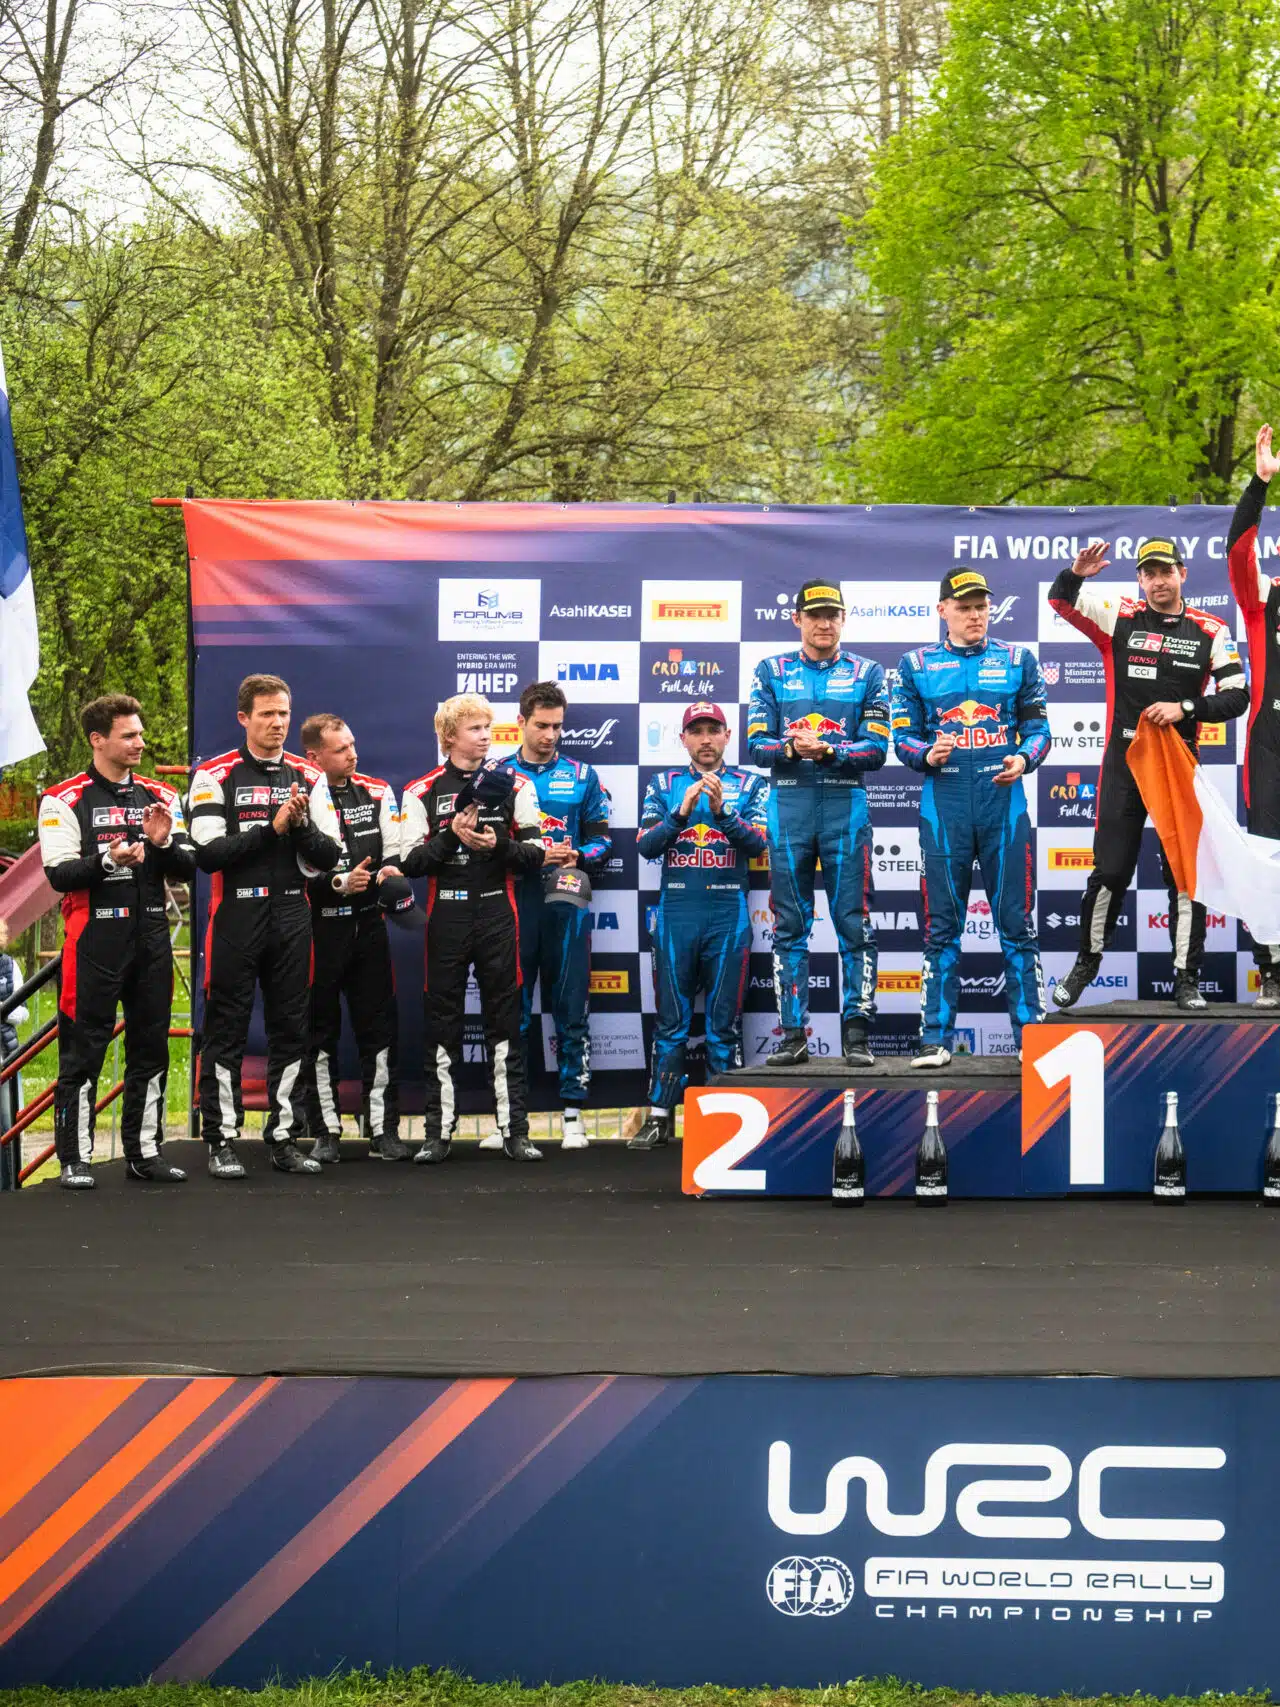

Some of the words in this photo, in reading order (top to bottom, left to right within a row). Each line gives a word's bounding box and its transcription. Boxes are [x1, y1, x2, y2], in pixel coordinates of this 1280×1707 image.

[953, 535, 999, 559] FIA
[1203, 595, 1229, 607] FUELS
[453, 610, 523, 619] FORUM8
[550, 604, 632, 618] AsahiKASEI
[658, 603, 722, 618] PIRELLI
[754, 608, 777, 621] TW
[850, 605, 930, 618] AsahiKASEI
[1129, 634, 1162, 652] GR
[1164, 636, 1200, 646] TOYOTA
[1164, 642, 1197, 651] GAZOO
[1162, 648, 1195, 657] Racing
[1128, 655, 1157, 665] DENSO
[652, 659, 723, 676] CROATIA
[1064, 668, 1097, 677] Ministry
[478, 673, 518, 693] HEP
[972, 725, 1009, 748] Bull
[1051, 736, 1074, 748] TW
[1077, 736, 1104, 748] STE
[236, 791, 269, 804] GR
[897, 791, 906, 800] of
[1050, 783, 1095, 800] CROA
[343, 803, 375, 813] TOYOTA
[891, 800, 904, 808] and
[94, 810, 126, 826] GR
[238, 811, 268, 819] DENSO
[344, 811, 373, 819] GAZOO
[344, 816, 373, 825] Racing
[97, 832, 127, 841] DENSO
[667, 848, 701, 868] Red
[701, 848, 736, 868] Bull
[1055, 852, 1094, 867] PIRE
[878, 860, 922, 872] STEEL
[237, 889, 253, 897] OMP
[870, 912, 919, 930] NA
[878, 973, 921, 990] RELLI
[1152, 981, 1174, 993] TW
[1198, 982, 1223, 993] EEL
[756, 1035, 830, 1056] Zaeb
[988, 1044, 1017, 1054] ZAGR
[1032, 1030, 1105, 1185] 1
[693, 1092, 770, 1190] 2
[767, 1440, 1227, 1542] WRC
[876, 1569, 929, 1586] FIA
[942, 1570, 1073, 1588] WORLD
[1086, 1573, 1213, 1590] RALLY
[875, 1604, 1213, 1623] CHAMPIONSHIP
